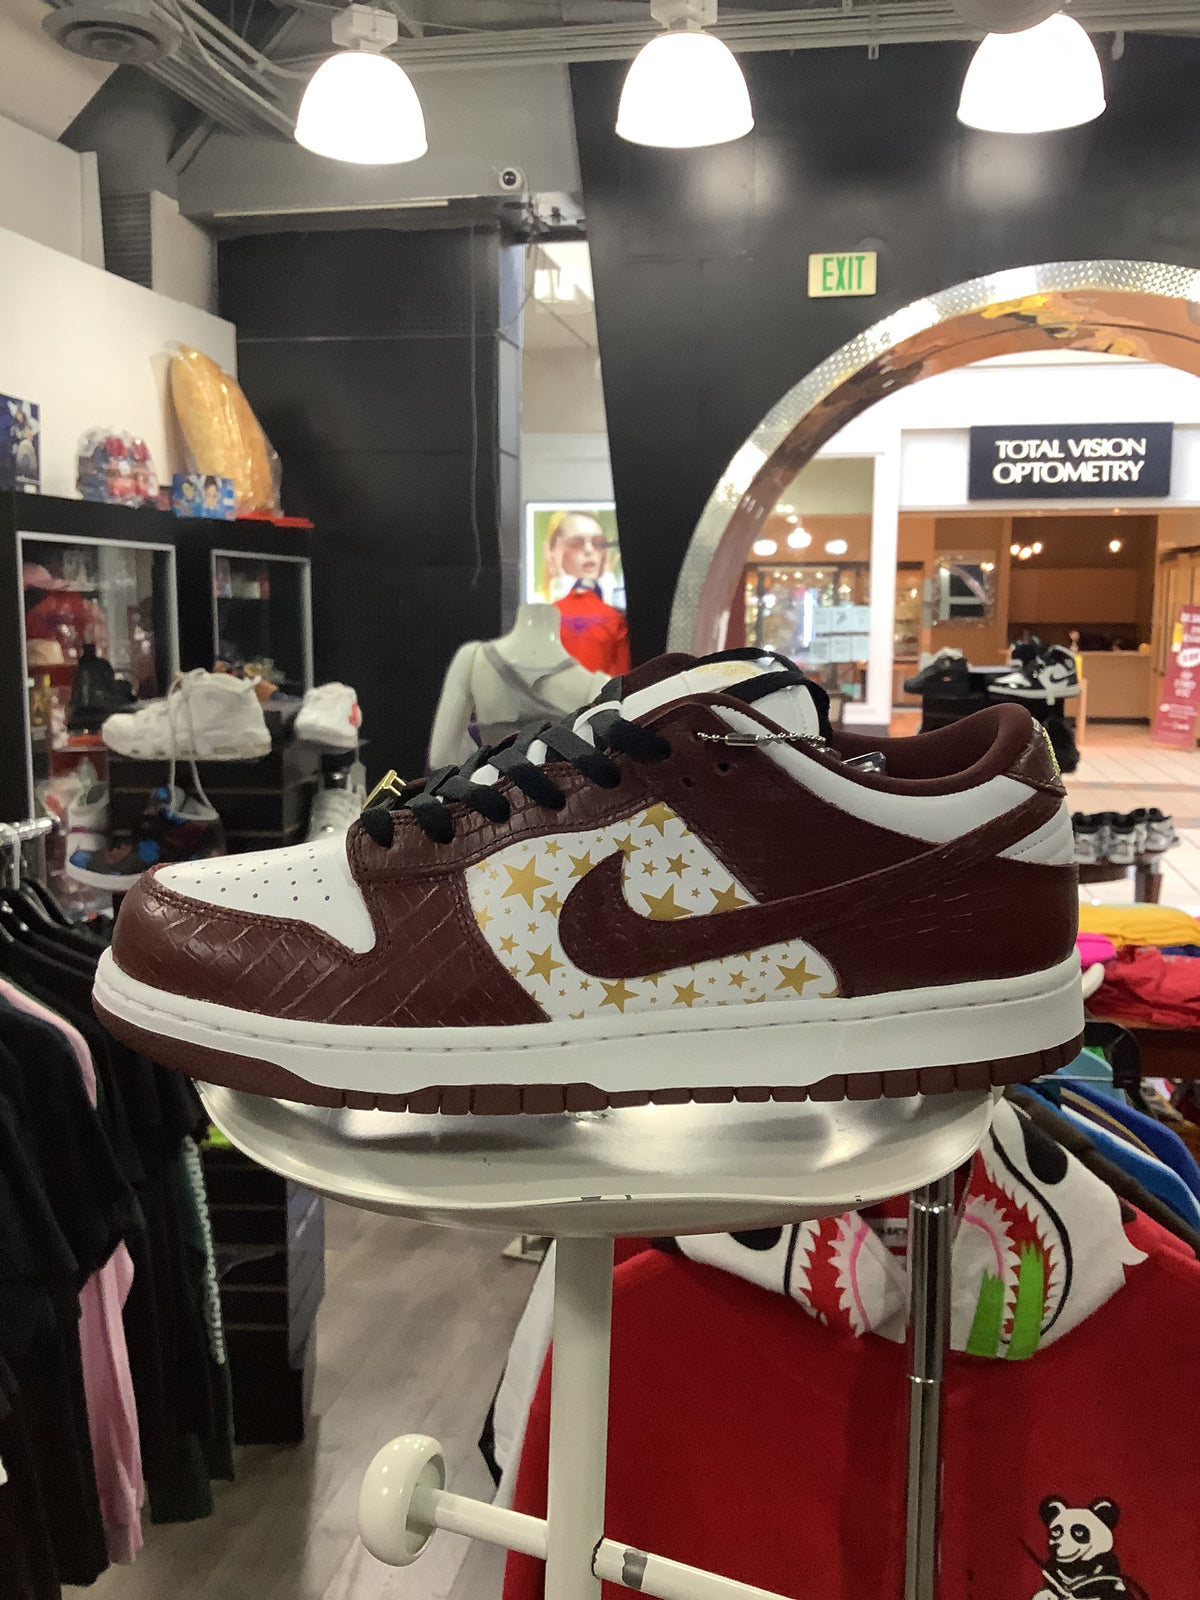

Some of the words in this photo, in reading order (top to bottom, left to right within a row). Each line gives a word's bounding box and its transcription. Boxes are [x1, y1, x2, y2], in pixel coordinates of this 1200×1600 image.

[823, 256, 866, 291] EXIT
[995, 439, 1065, 459] TOTAL
[1067, 438, 1147, 458] VISION
[992, 460, 1145, 484] OPTOMETRY
